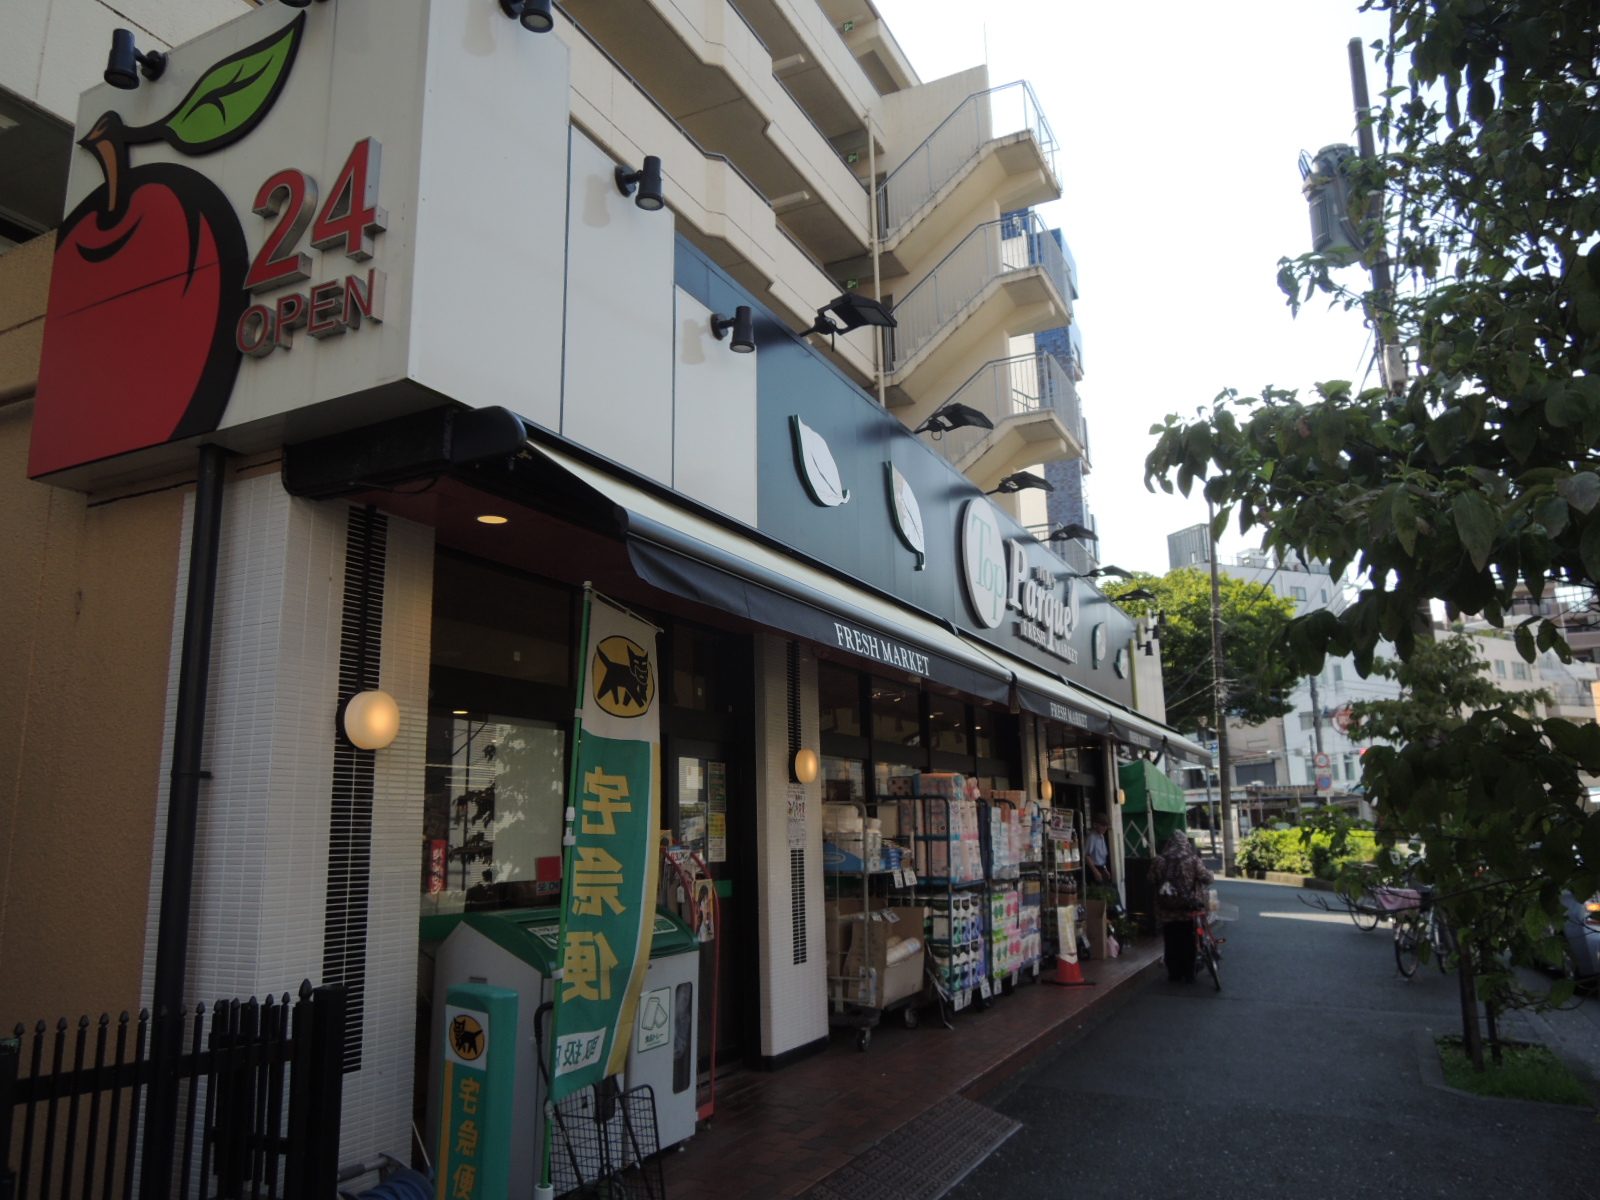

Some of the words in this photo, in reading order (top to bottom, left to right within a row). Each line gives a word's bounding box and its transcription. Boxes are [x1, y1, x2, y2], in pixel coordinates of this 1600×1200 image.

[243, 137, 388, 294] 24
[236, 267, 387, 358] OPEN
[971, 514, 1005, 621] Top
[1006, 539, 1073, 651] Parque
[834, 622, 881, 660] FRESH
[880, 640, 931, 676] MARKET
[1020, 620, 1047, 647] FRESH
[1050, 702, 1068, 722] FRESH
[453, 1076, 481, 1200] 宅急便
